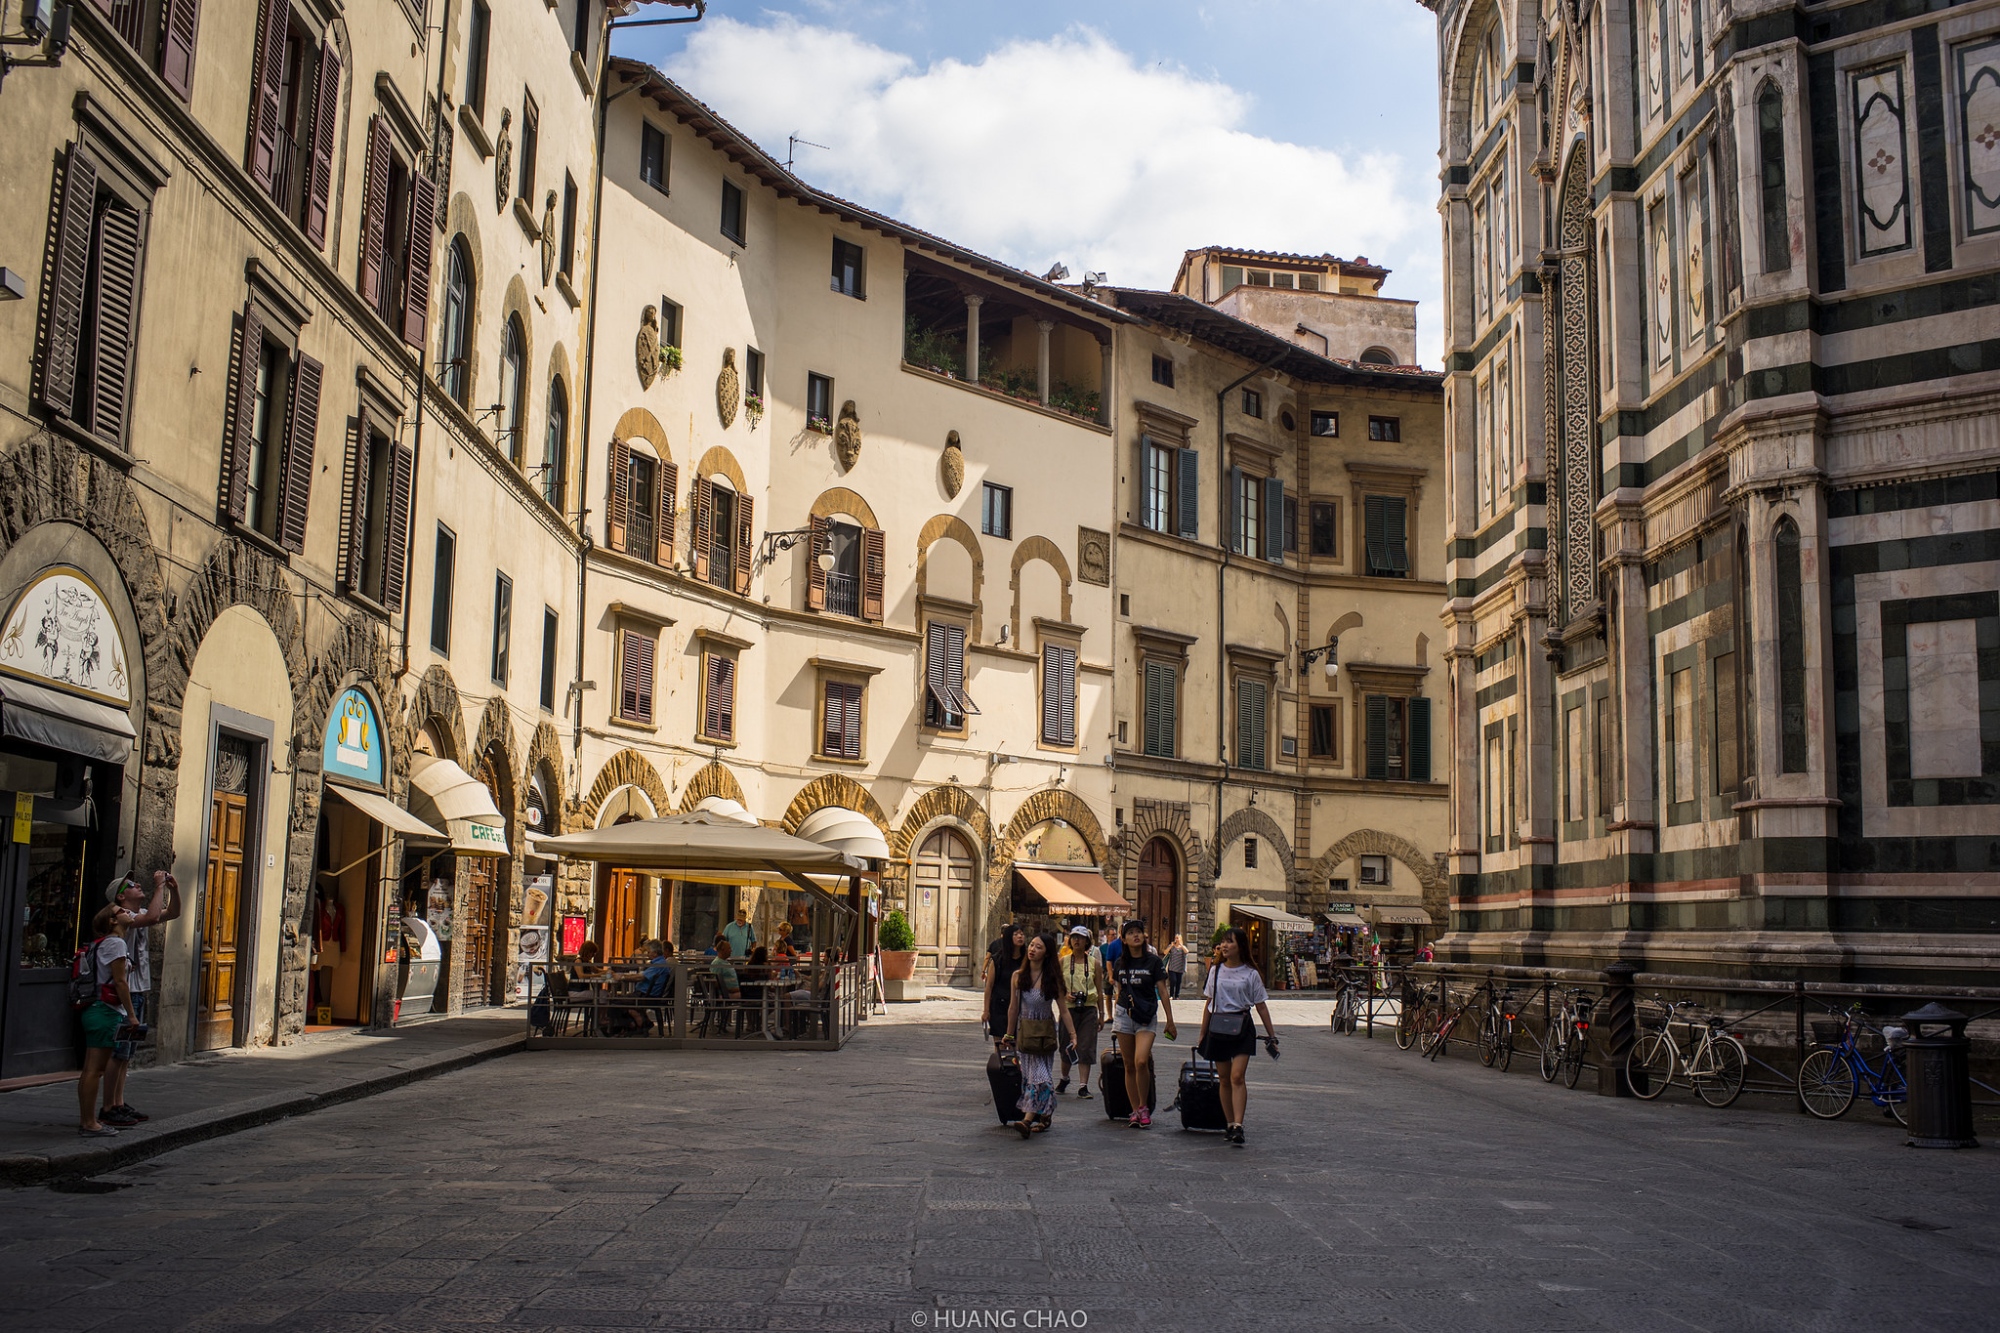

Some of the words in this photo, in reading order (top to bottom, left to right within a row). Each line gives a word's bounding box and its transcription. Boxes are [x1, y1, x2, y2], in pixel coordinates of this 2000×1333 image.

[18, 793, 32, 804] STAMPS
[1390, 916, 1424, 924] MONTI
[1280, 922, 1286, 930] IL
